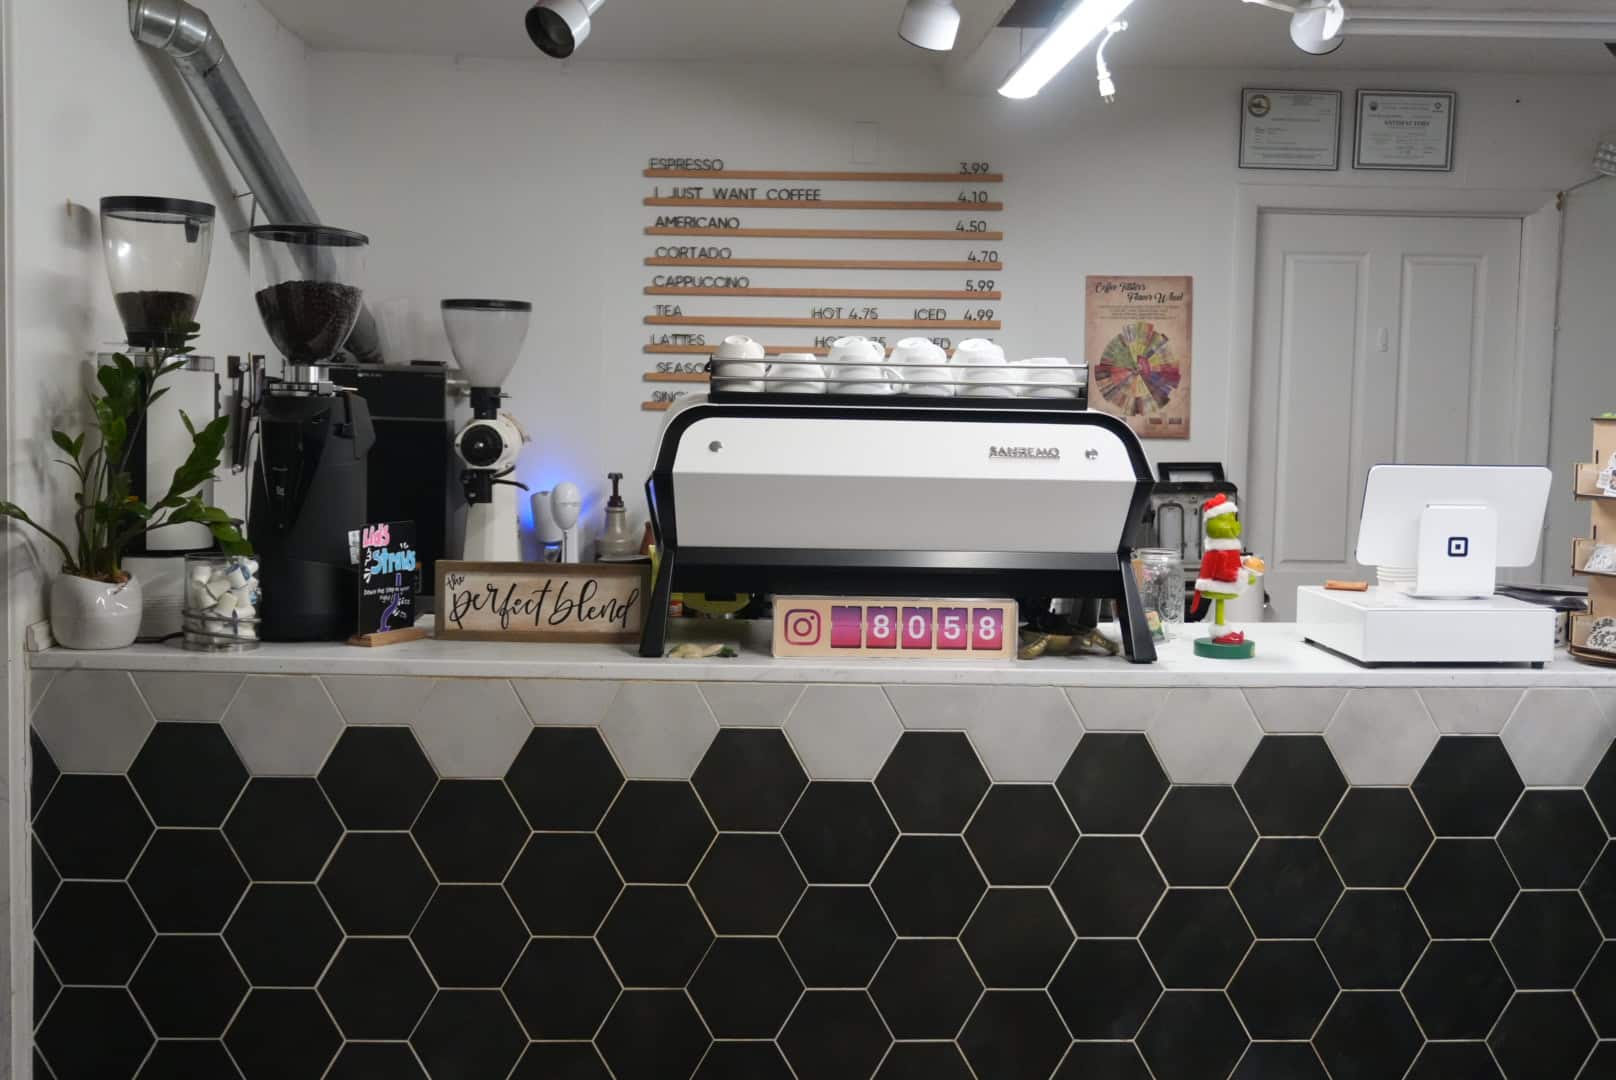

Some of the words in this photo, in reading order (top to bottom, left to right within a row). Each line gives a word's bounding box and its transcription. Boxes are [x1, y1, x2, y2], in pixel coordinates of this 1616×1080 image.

[650, 158, 724, 171] ESPRESSO
[959, 162, 990, 175] 3.99
[668, 187, 704, 199] JUST
[712, 188, 758, 200] WANT
[766, 189, 822, 201] COFFEE
[957, 191, 989, 204] 4.10
[655, 216, 740, 229] AMERICANO
[955, 220, 987, 233] 4.50
[655, 246, 732, 259] CORTADO
[967, 250, 999, 263] 4.70
[652, 275, 750, 288] CAPPUCCINO
[964, 280, 995, 292] 5.99
[656, 304, 683, 317] TEA
[811, 307, 843, 320] HOT
[848, 307, 878, 320] 4.75
[913, 308, 947, 321] ICED
[963, 308, 994, 321] 4.99
[651, 333, 705, 346] LATTES
[814, 336, 843, 348] HO
[656, 361, 707, 374] SEASO
[989, 446, 1060, 459] SANREMO
[445, 573, 465, 590] the
[449, 578, 552, 630] perfect
[548, 579, 640, 629] blend
